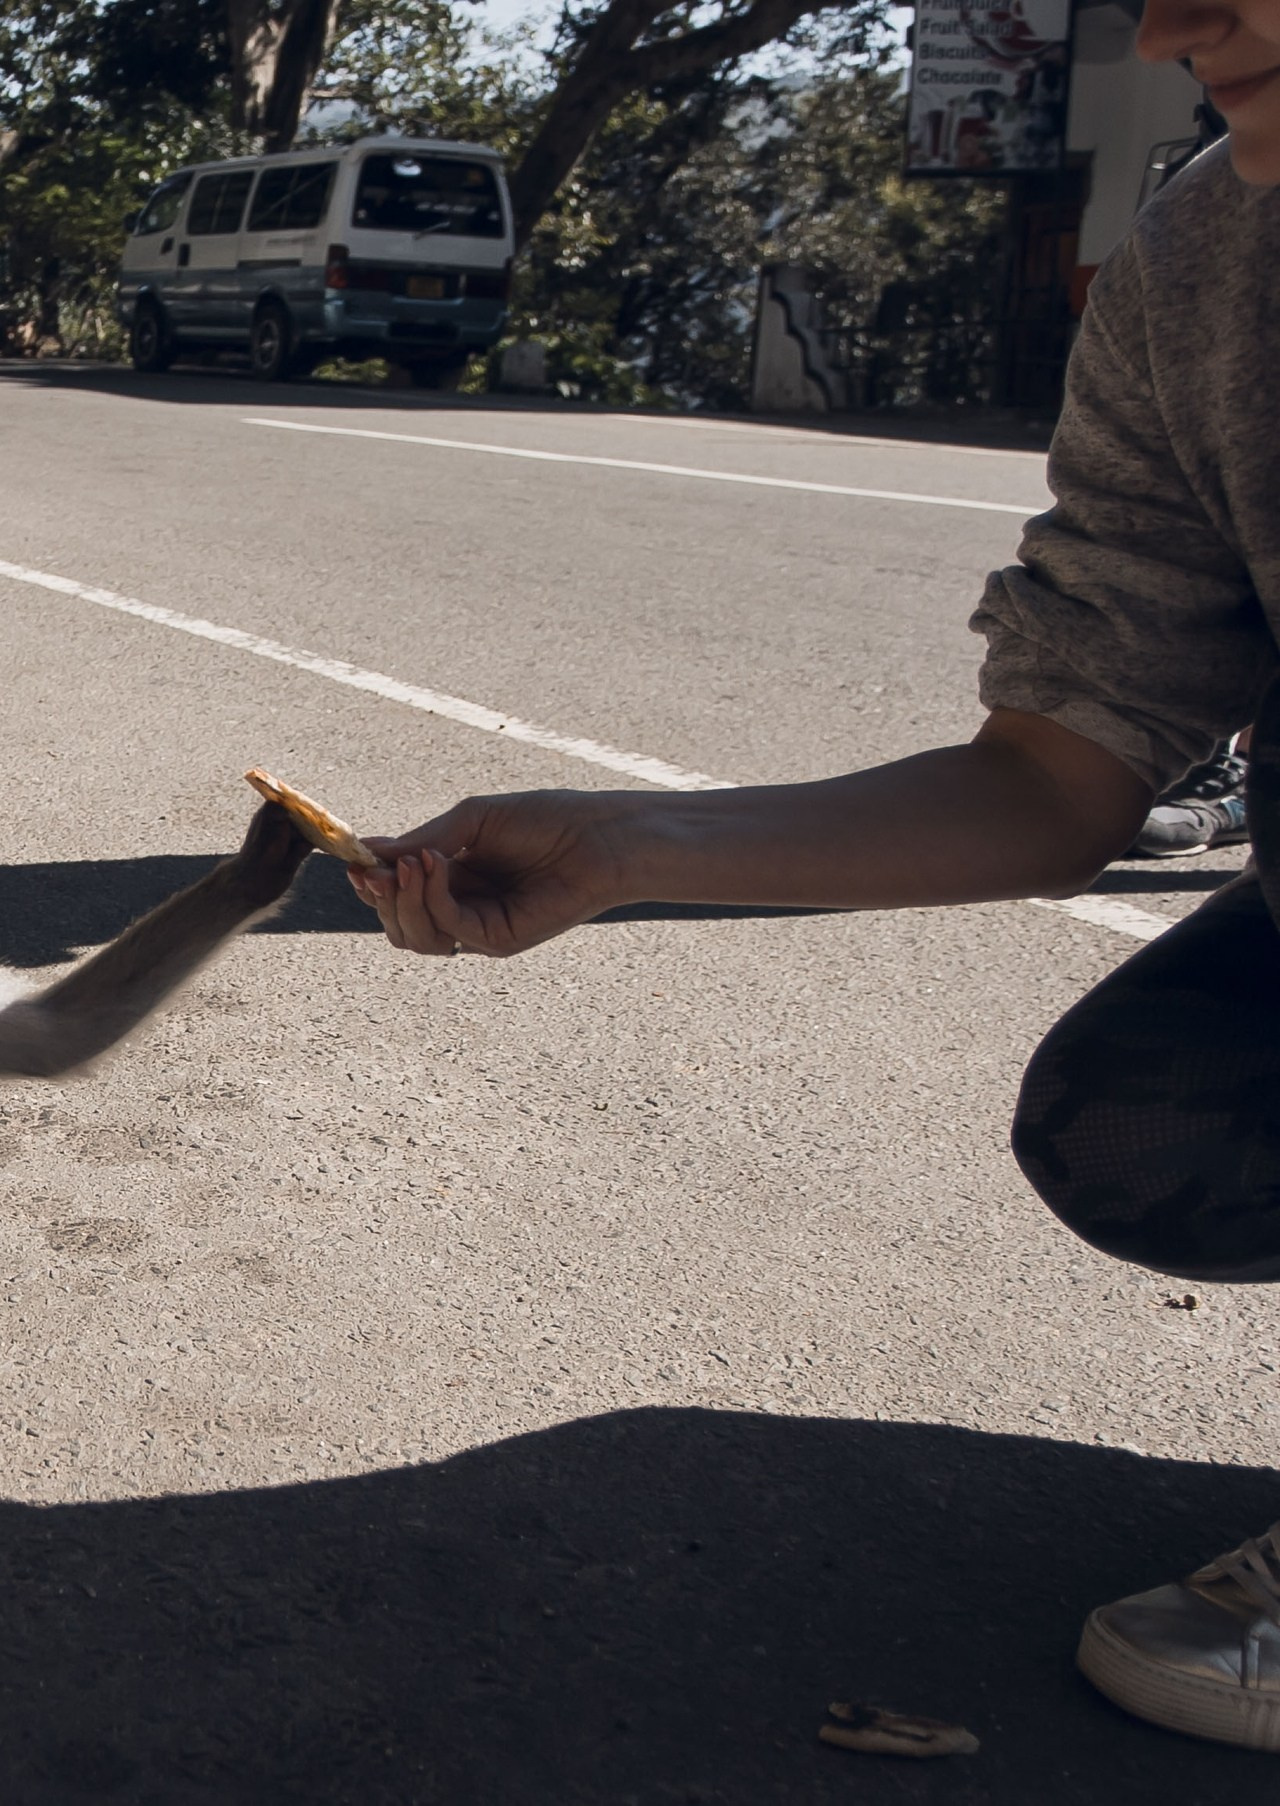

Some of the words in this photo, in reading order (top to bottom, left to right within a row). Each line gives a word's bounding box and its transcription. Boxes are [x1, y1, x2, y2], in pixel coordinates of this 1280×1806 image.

[920, 18, 958, 34] Fruit
[966, 18, 1011, 35] Salad
[917, 67, 1002, 84] Chocolate
